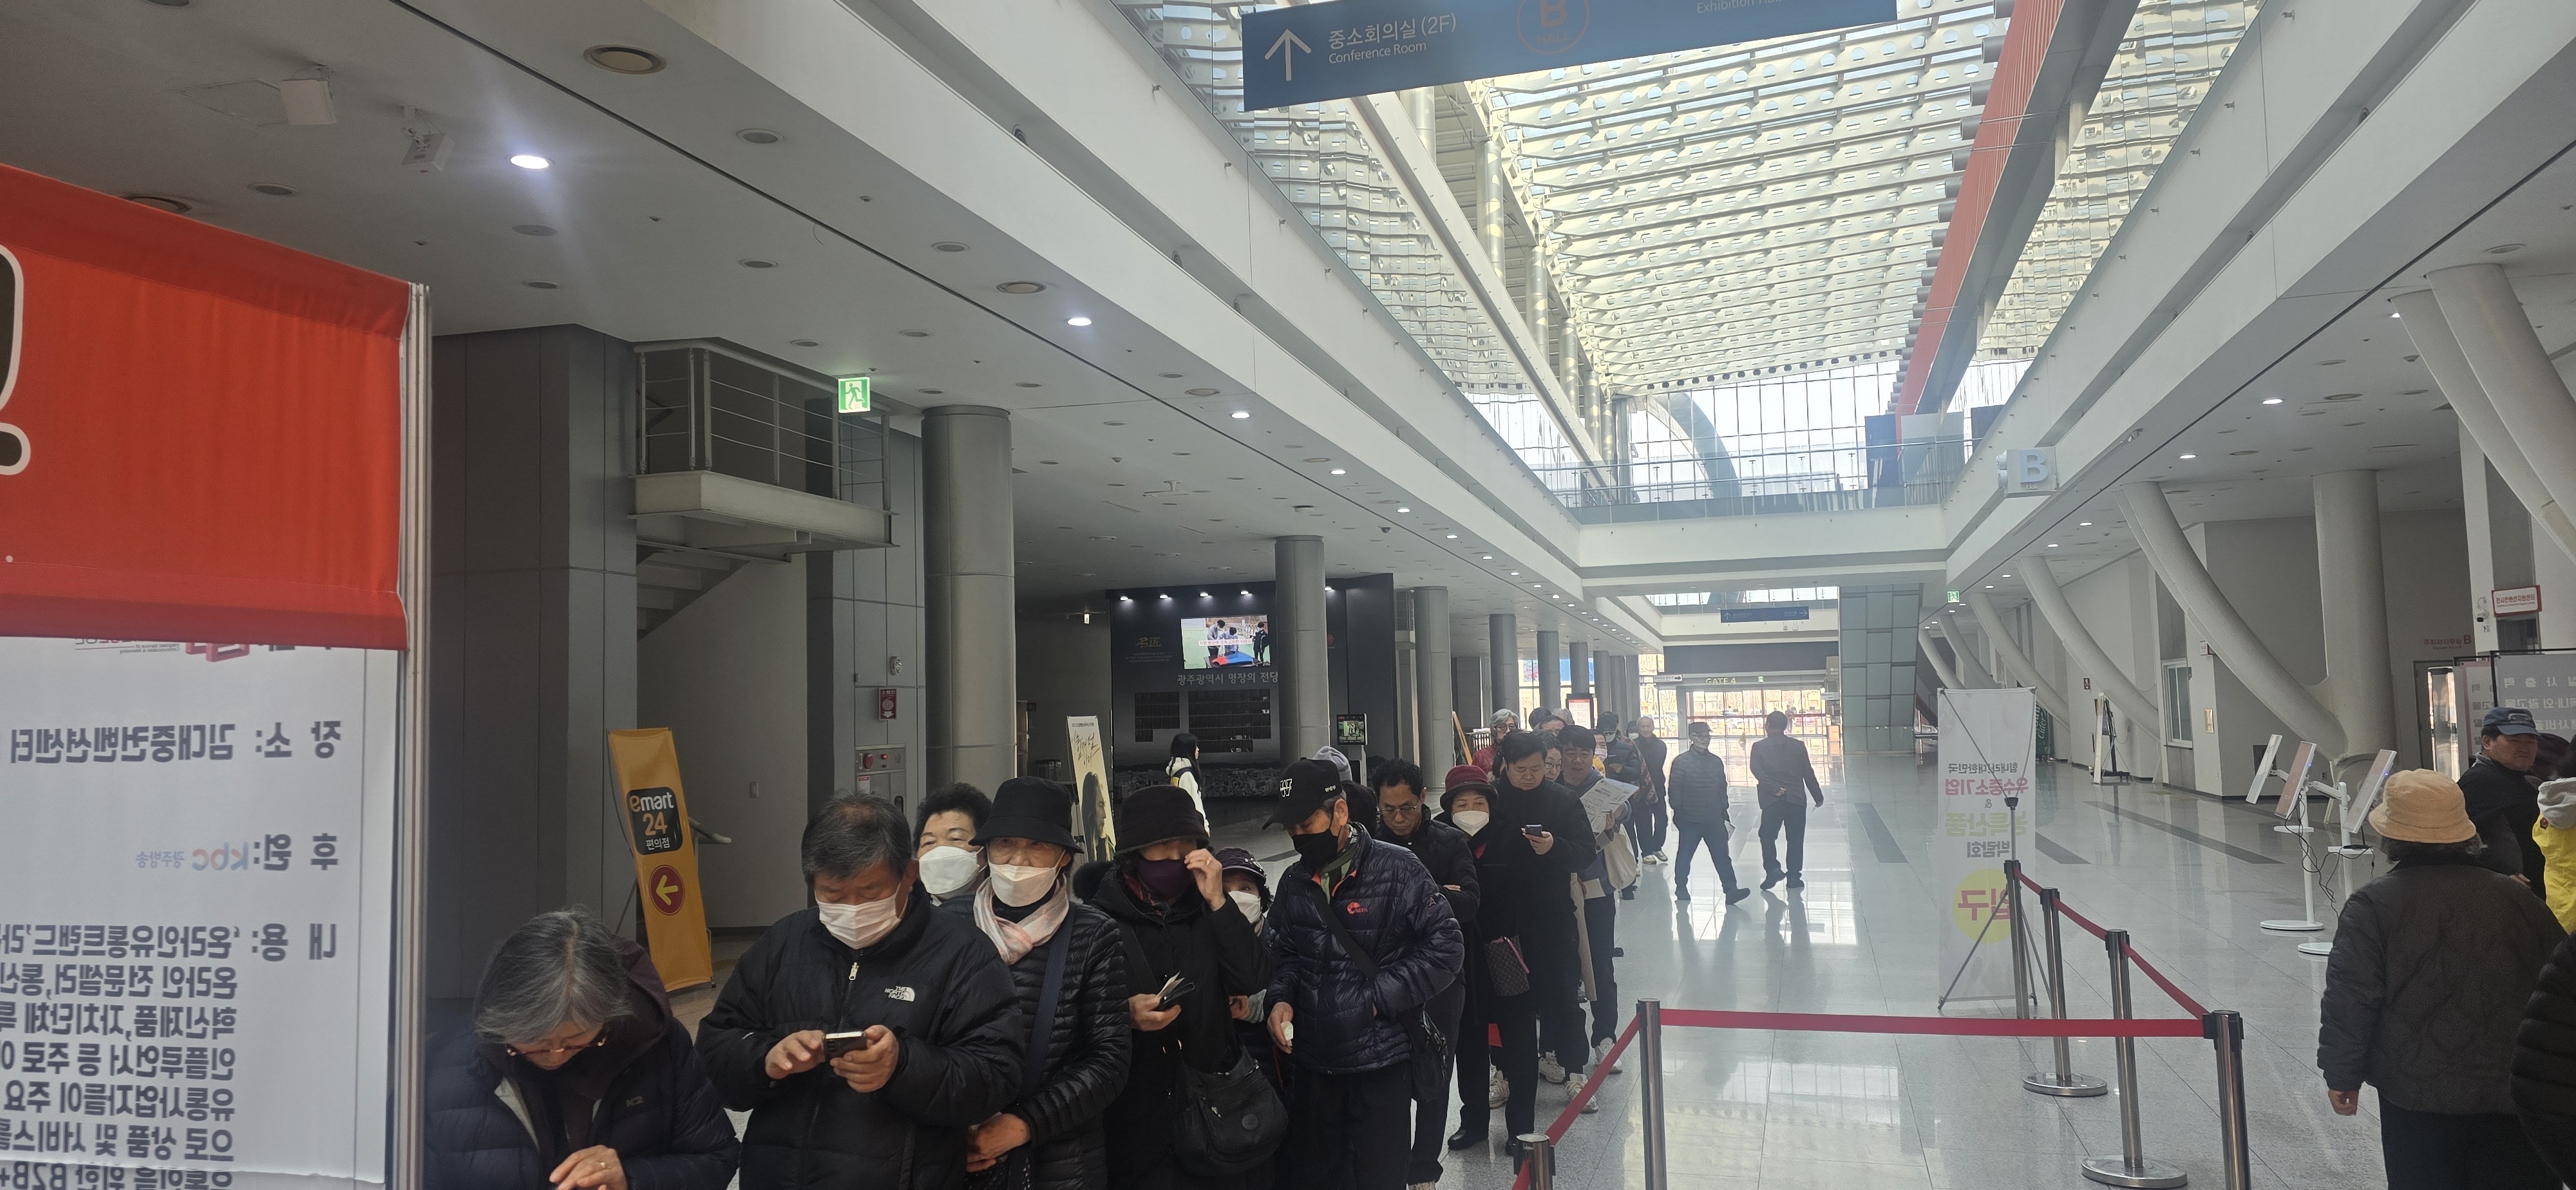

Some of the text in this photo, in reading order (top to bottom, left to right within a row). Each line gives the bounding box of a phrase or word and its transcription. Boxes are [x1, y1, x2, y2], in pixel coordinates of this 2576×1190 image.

[1328, 15, 1456, 50] 중소회의실 (2F)
[1328, 42, 1427, 64] Conference Room
[2019, 449, 2048, 484] B
[1177, 671, 1279, 686] 광주광역시 명장의 전당
[629, 791, 674, 813] emart
[642, 811, 668, 836] 24
[645, 836, 670, 851] 편의점
